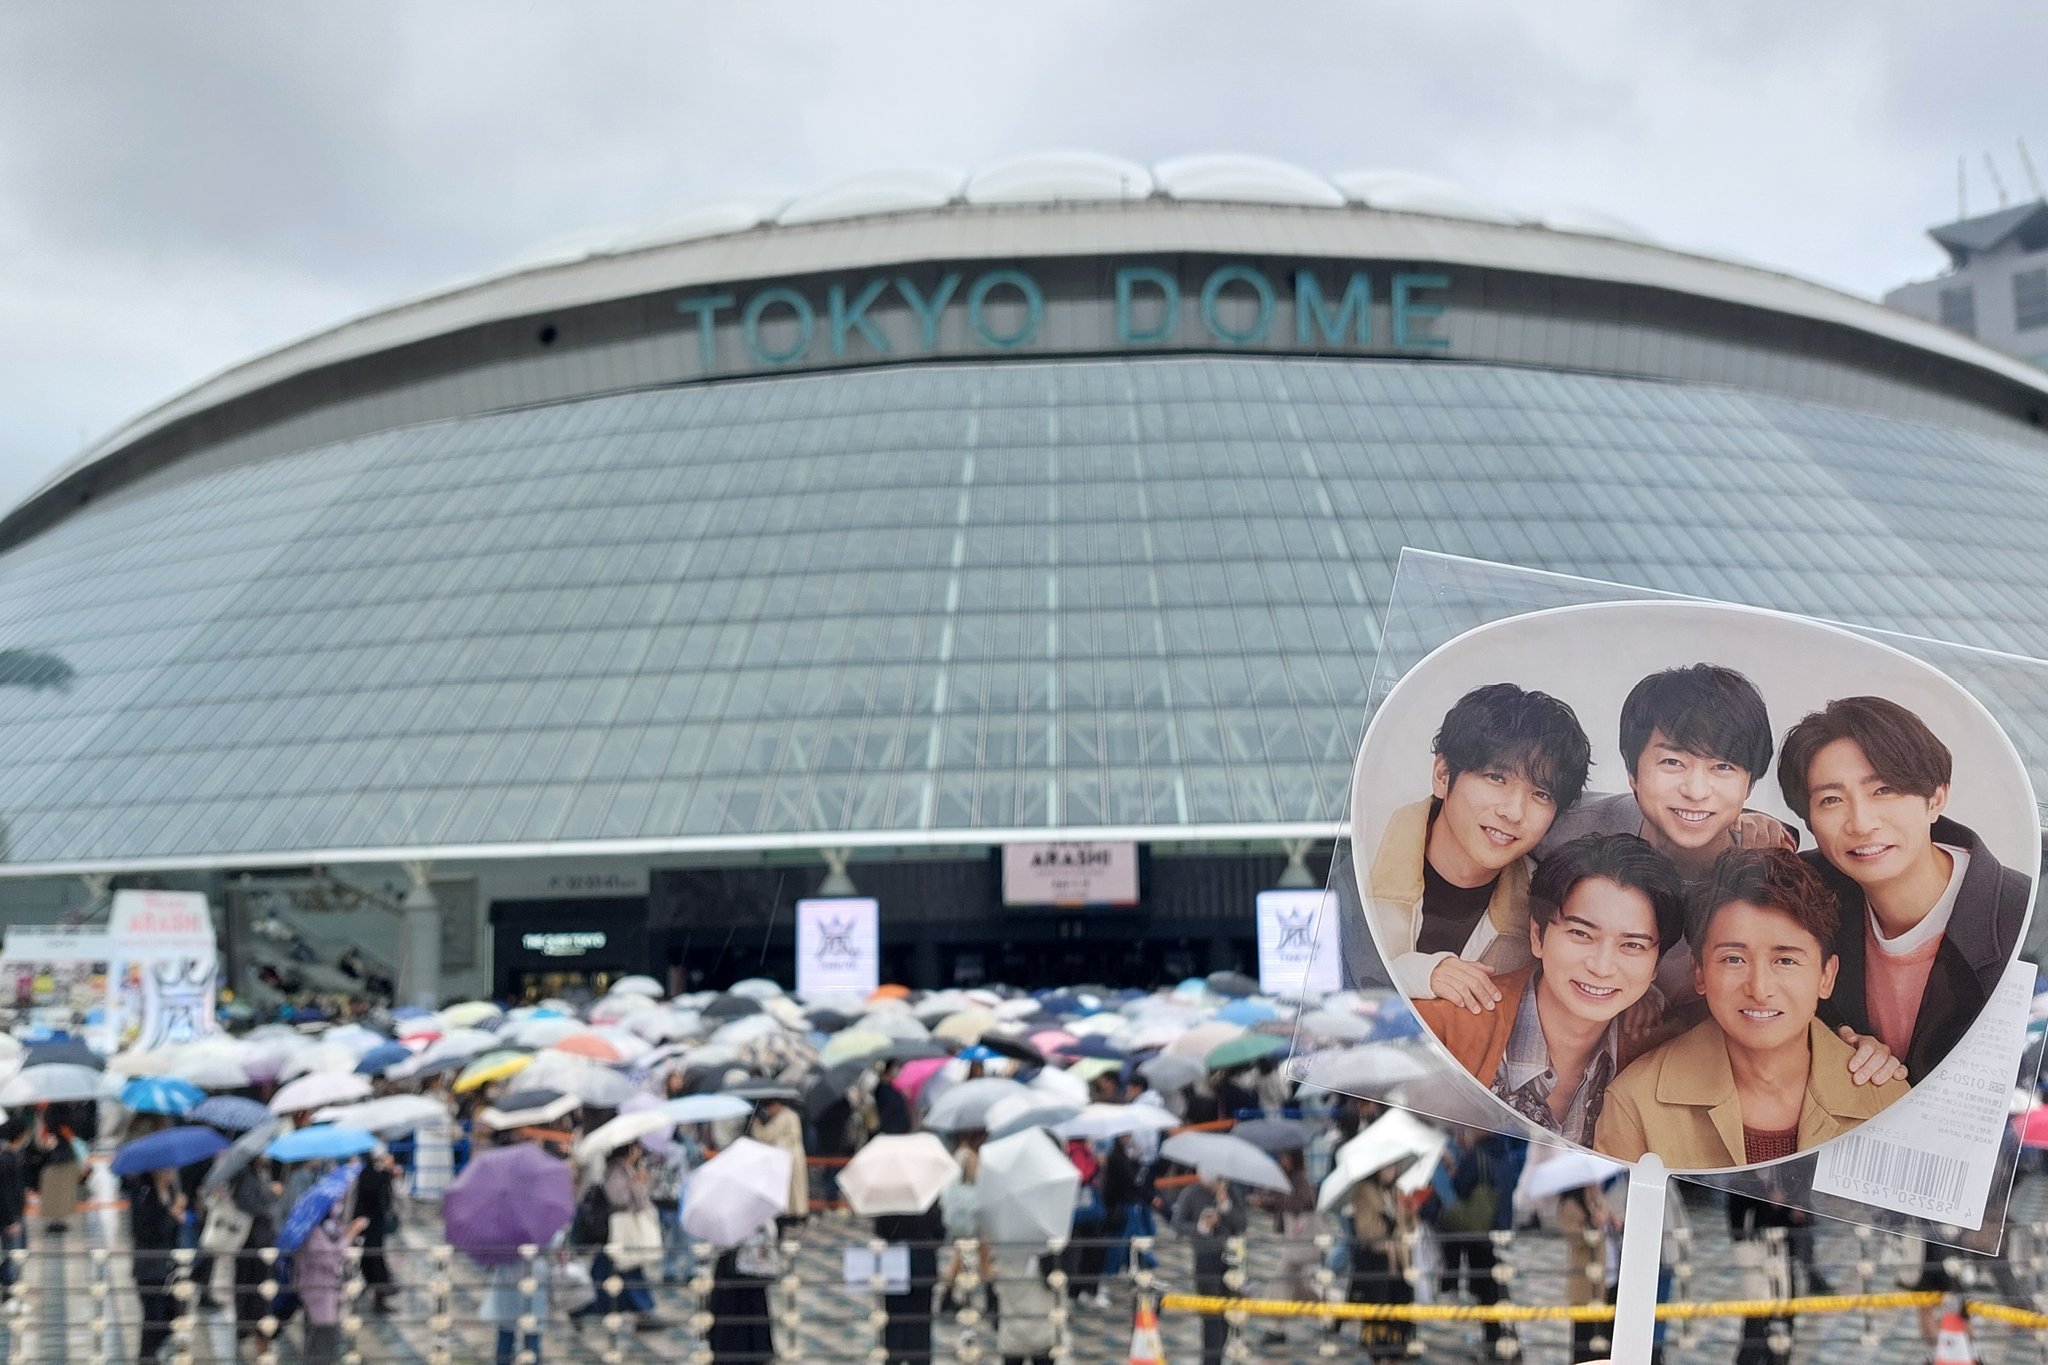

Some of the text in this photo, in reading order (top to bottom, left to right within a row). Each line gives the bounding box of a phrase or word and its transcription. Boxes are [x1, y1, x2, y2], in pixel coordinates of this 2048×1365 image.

[678, 265, 1452, 371] TOKYO DOME
[1031, 850, 1110, 867] ARASHI
